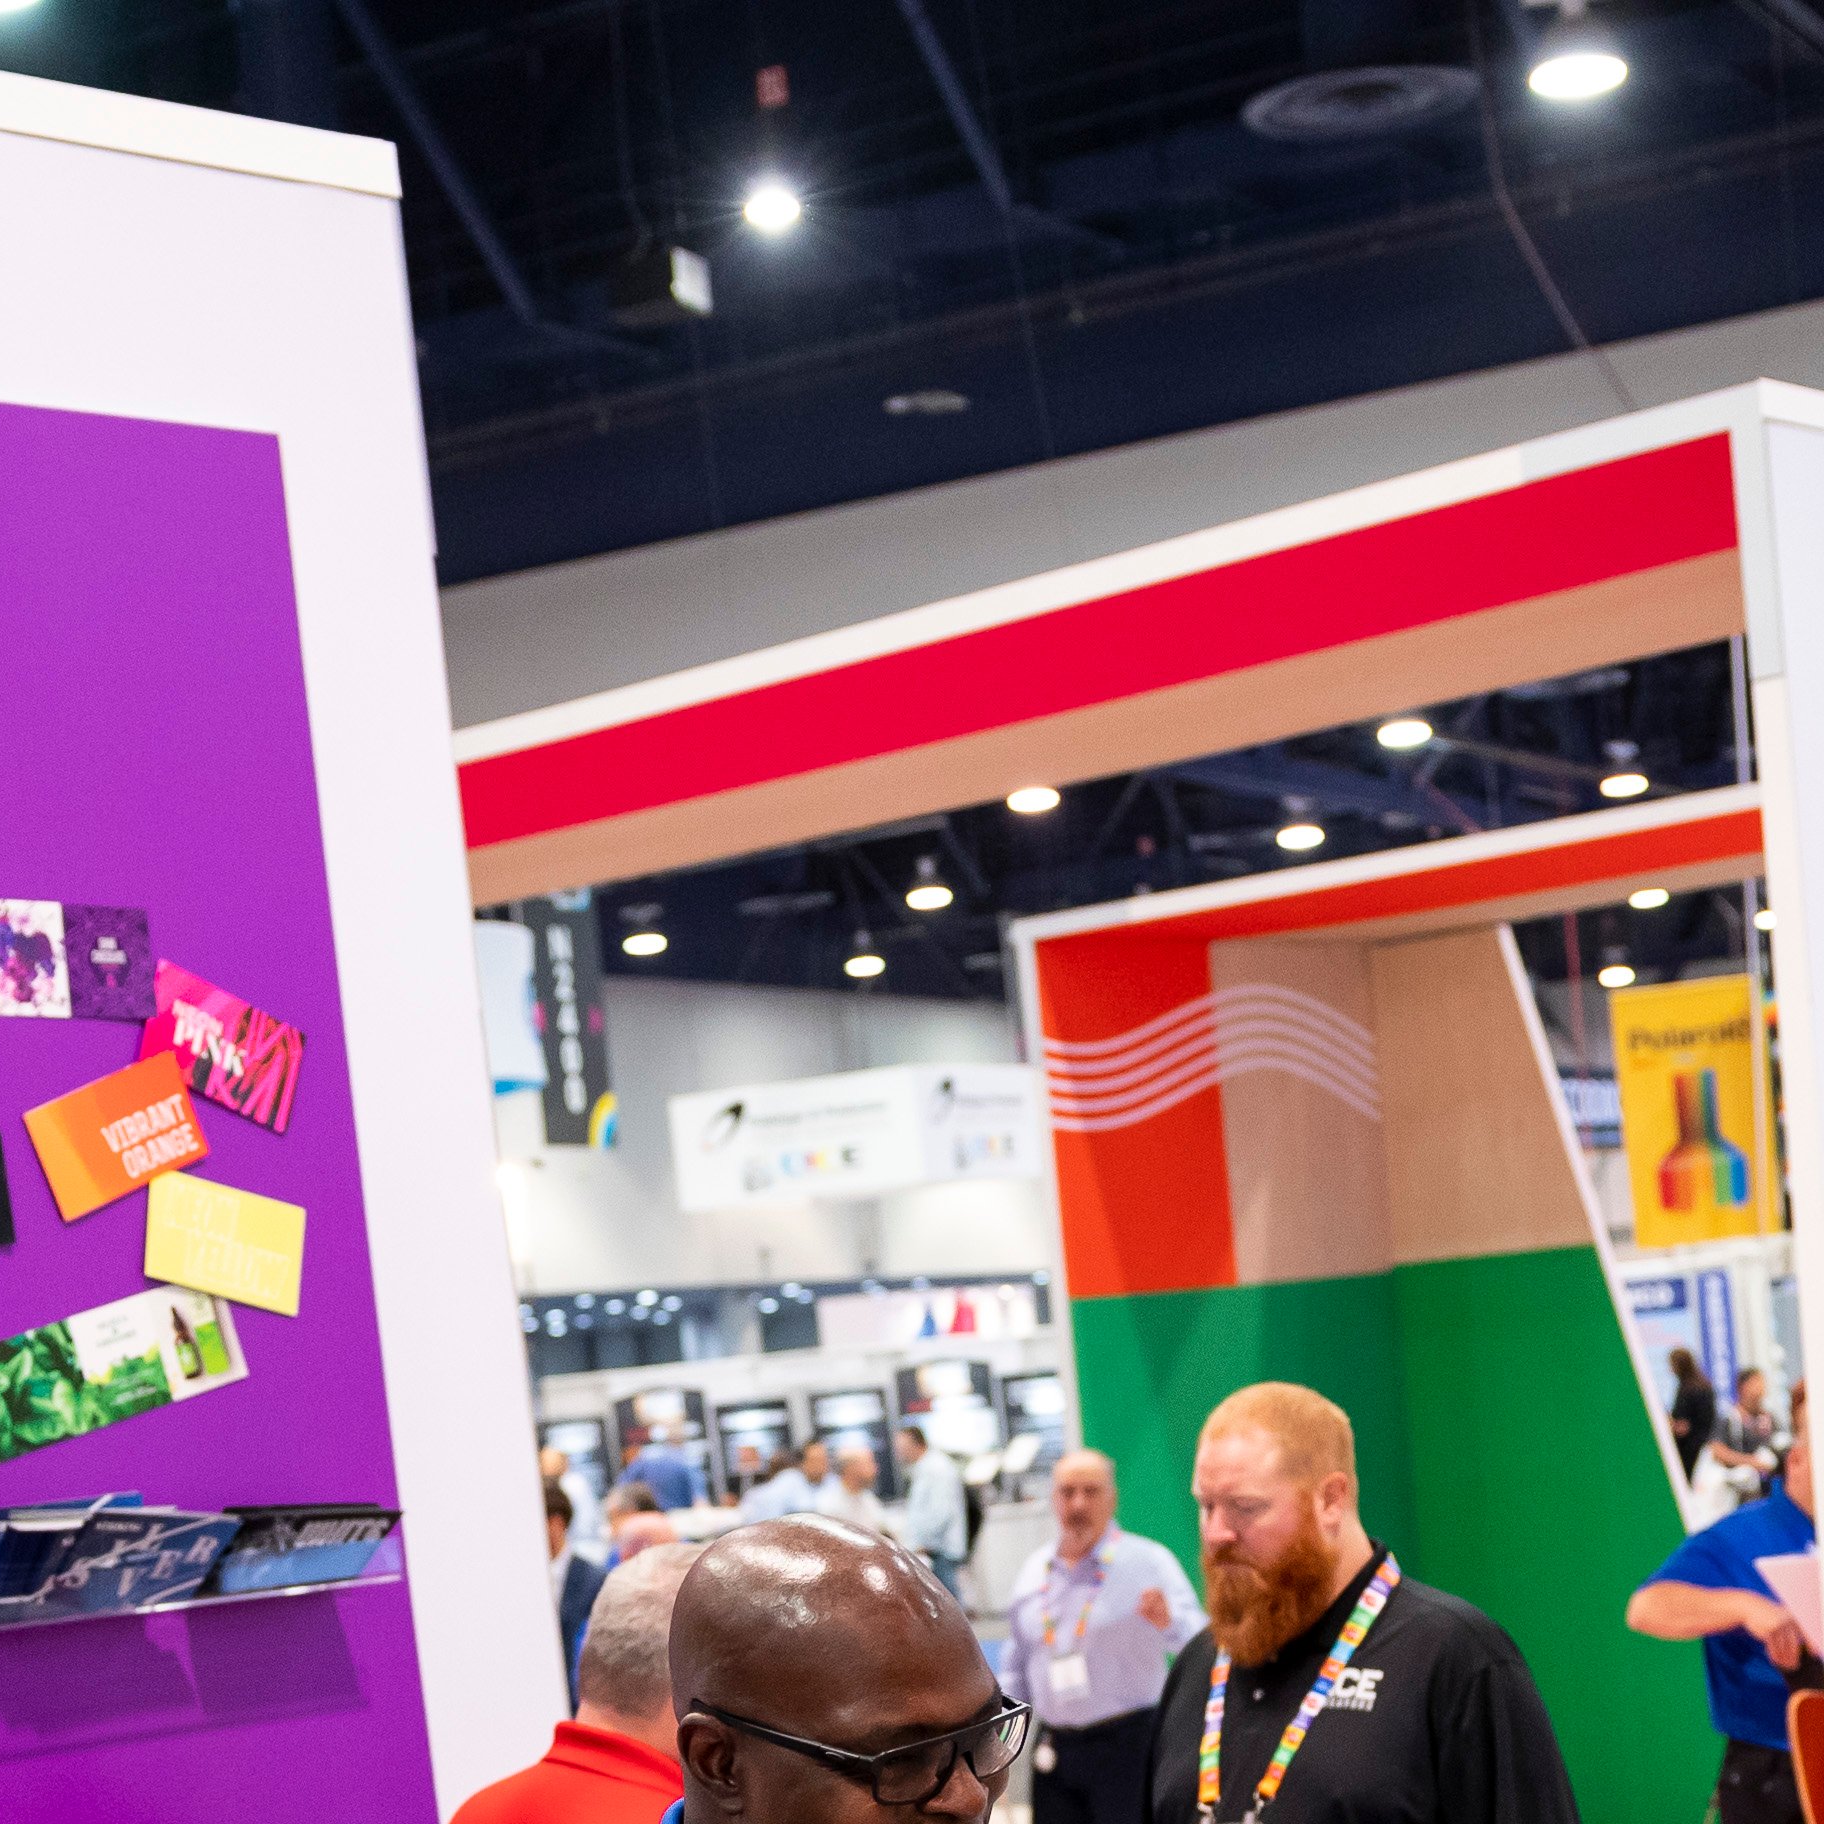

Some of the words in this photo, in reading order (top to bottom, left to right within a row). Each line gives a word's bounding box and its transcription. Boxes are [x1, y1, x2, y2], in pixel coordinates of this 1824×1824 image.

[172, 1016, 249, 1078] PINK
[100, 1092, 186, 1153] VIBRANT
[121, 1122, 200, 1179] ORANGE
[1328, 1667, 1385, 1701] CE
